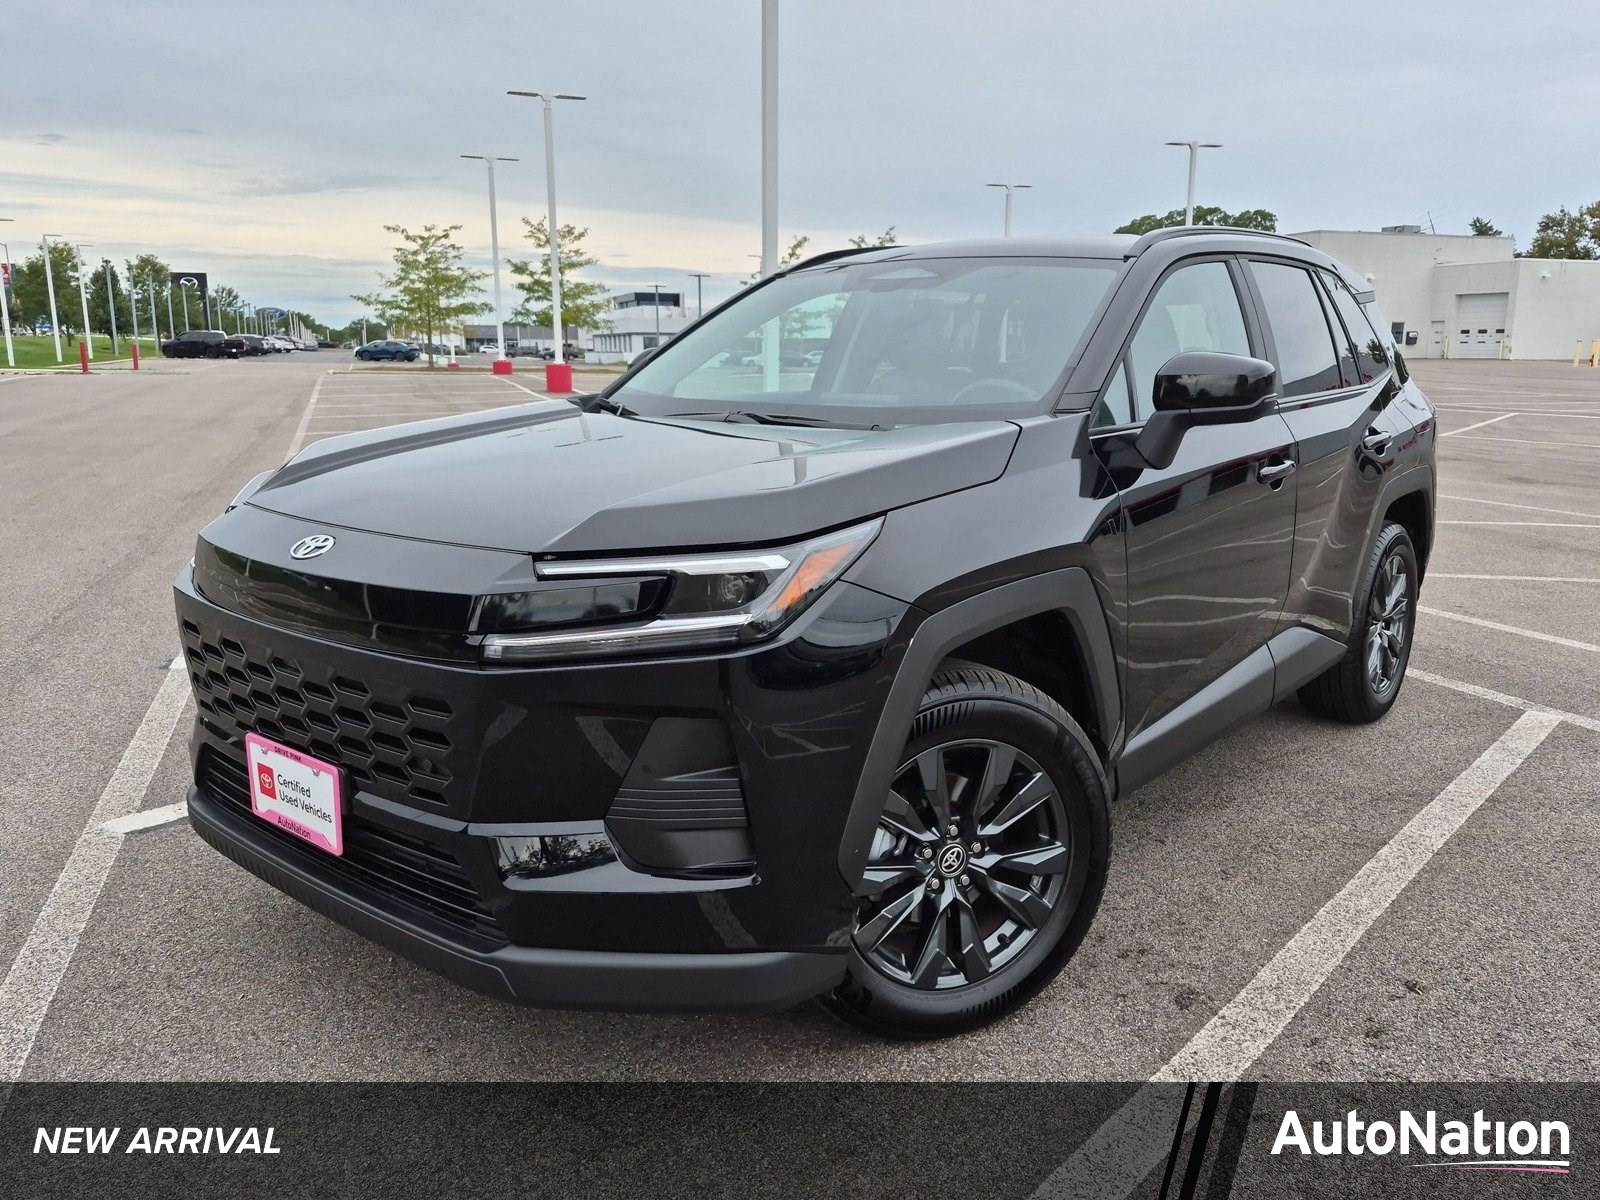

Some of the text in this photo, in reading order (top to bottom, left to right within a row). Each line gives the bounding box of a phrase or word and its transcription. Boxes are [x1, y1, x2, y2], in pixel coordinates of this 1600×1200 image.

[277, 774, 311, 798] Certified
[279, 790, 332, 823] Used Vehicles
[278, 816, 310, 839] AutoNation
